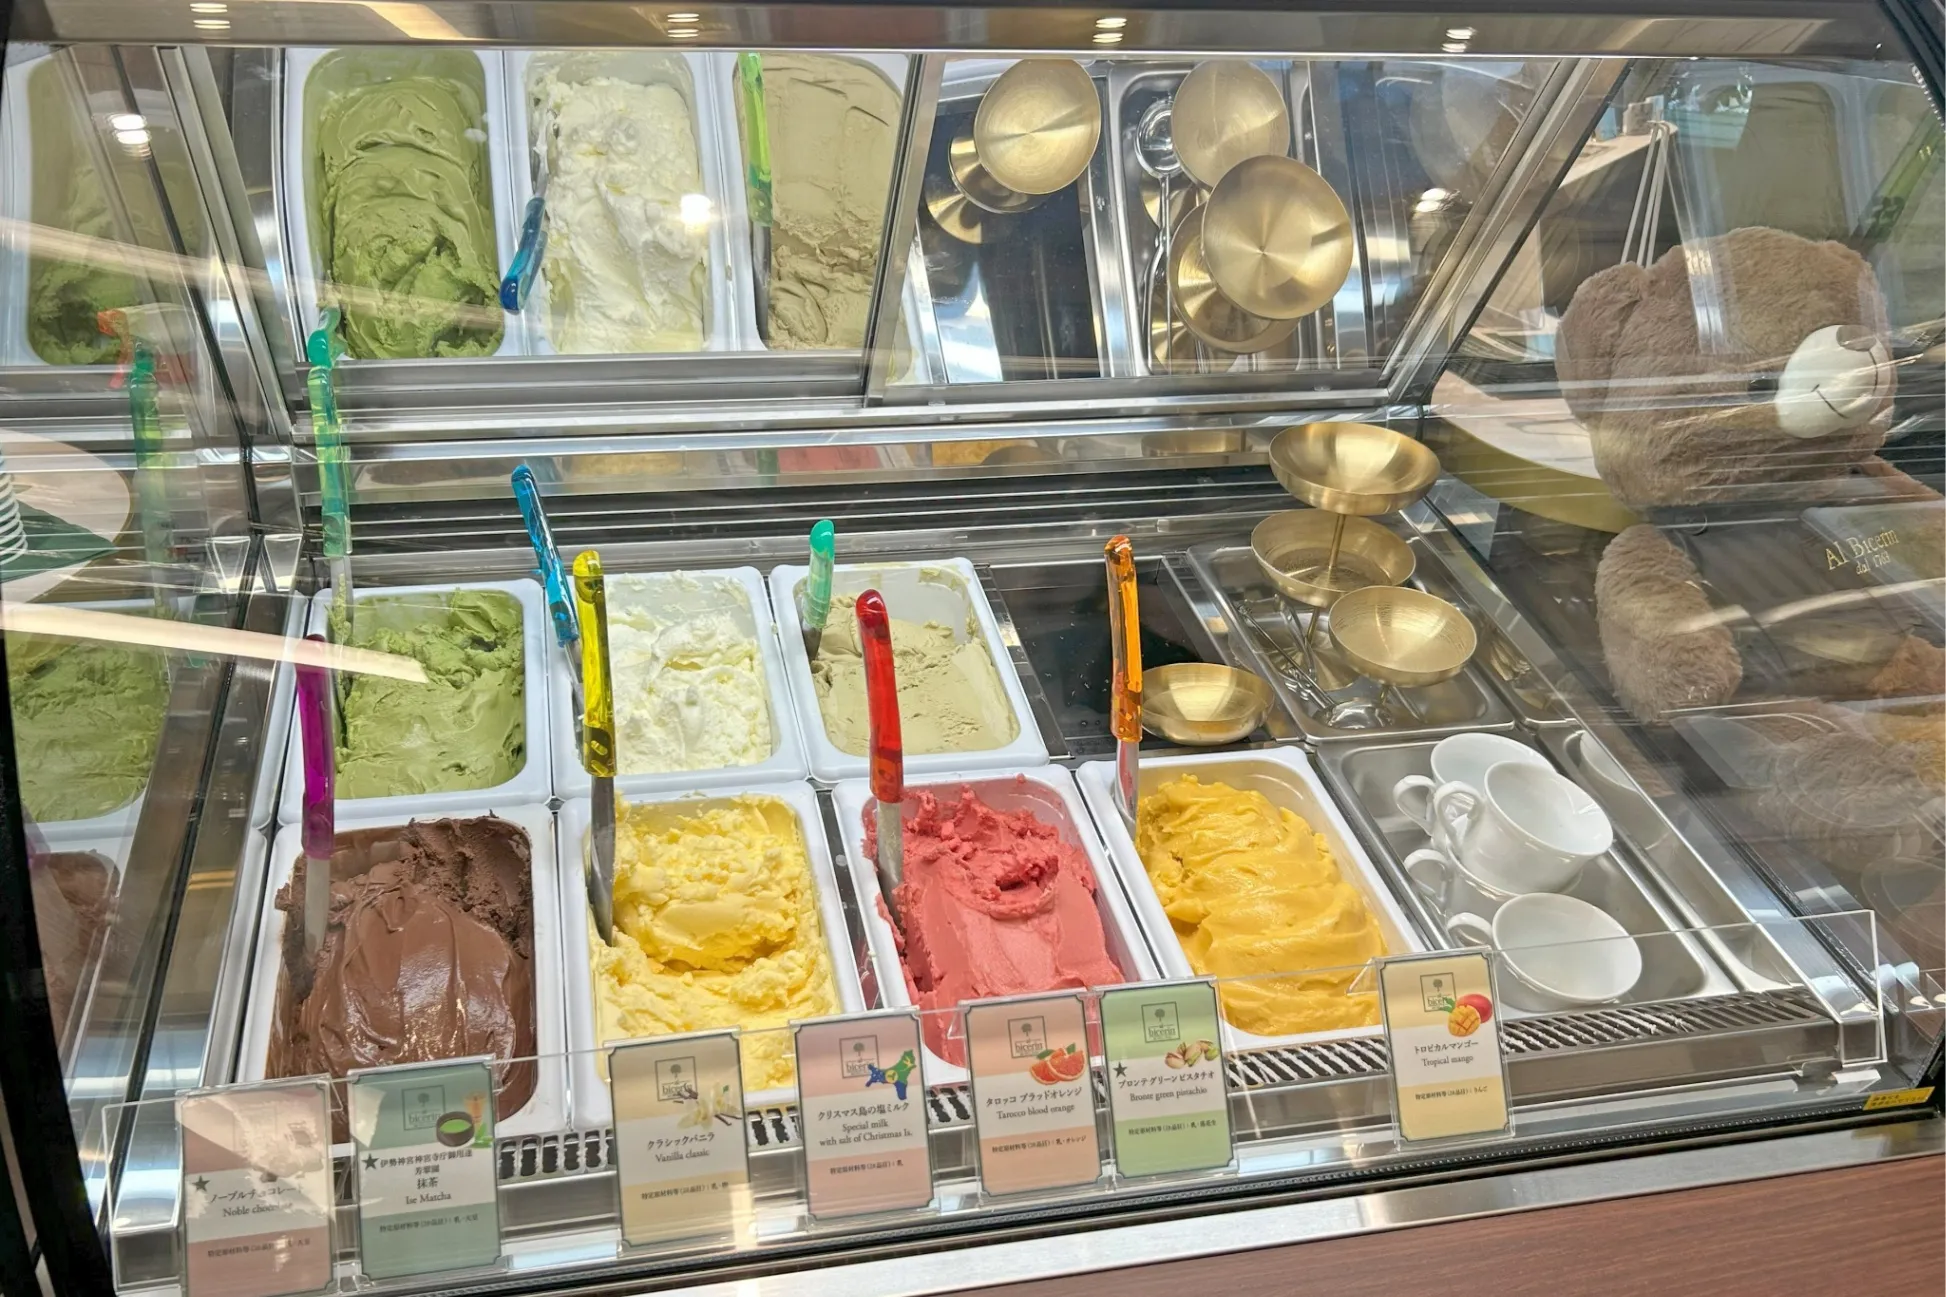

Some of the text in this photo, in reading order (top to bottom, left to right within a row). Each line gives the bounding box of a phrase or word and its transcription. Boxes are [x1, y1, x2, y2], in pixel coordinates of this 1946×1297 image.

[1825, 541, 1850, 570] Al
[1855, 560, 1871, 575] dal
[1414, 1040, 1480, 1055] トロピカルマンゴー
[1421, 1055, 1474, 1068] Tropical mango
[986, 1086, 1083, 1108] タロッコ ブラッドオレンジ
[1130, 1086, 1208, 1102] Bronte green pistachio
[818, 1101, 910, 1121] クリスマス島の塩ミルク
[996, 1104, 1075, 1120] Tarocco blood orange
[842, 1118, 889, 1134] Special milk
[647, 1131, 716, 1151] クラシックバニラ
[819, 1135, 837, 1147] with
[839, 1134, 852, 1145] salt
[853, 1132, 862, 1143] of
[863, 1131, 902, 1143] Christmas
[655, 1147, 711, 1163] Vanilla classic
[417, 1177, 439, 1190] 抹茶
[405, 1191, 452, 1205] Ise Matcha
[222, 1204, 251, 1218] Noble
